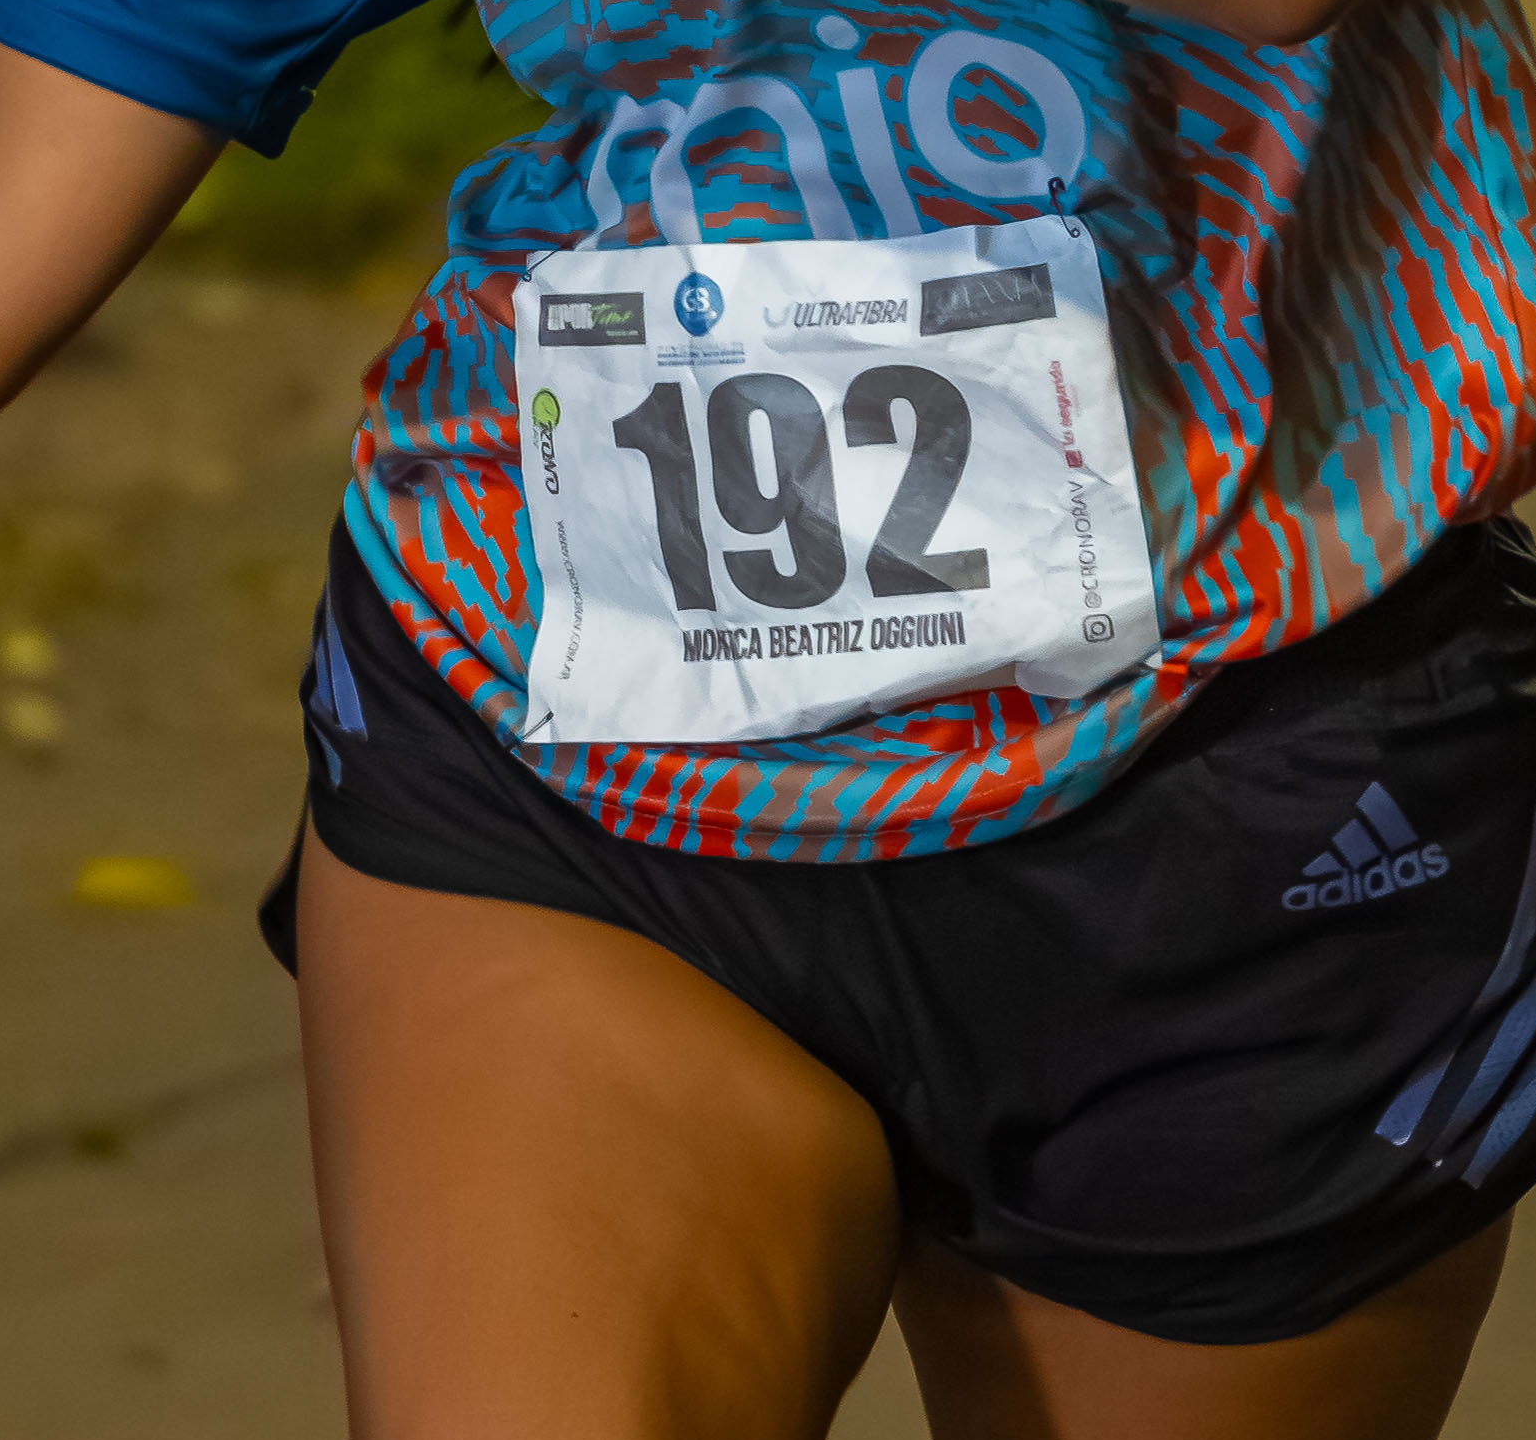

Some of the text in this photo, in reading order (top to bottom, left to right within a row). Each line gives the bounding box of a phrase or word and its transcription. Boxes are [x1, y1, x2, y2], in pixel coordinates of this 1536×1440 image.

[792, 298, 909, 329] ULTRAFIBRA
[613, 364, 991, 612] 192
[1067, 480, 1103, 609] @CRONORAV
[769, 618, 864, 658] BEATRIZ
[870, 611, 966, 650] OGGIUNI
[1281, 843, 1450, 911] adidas
